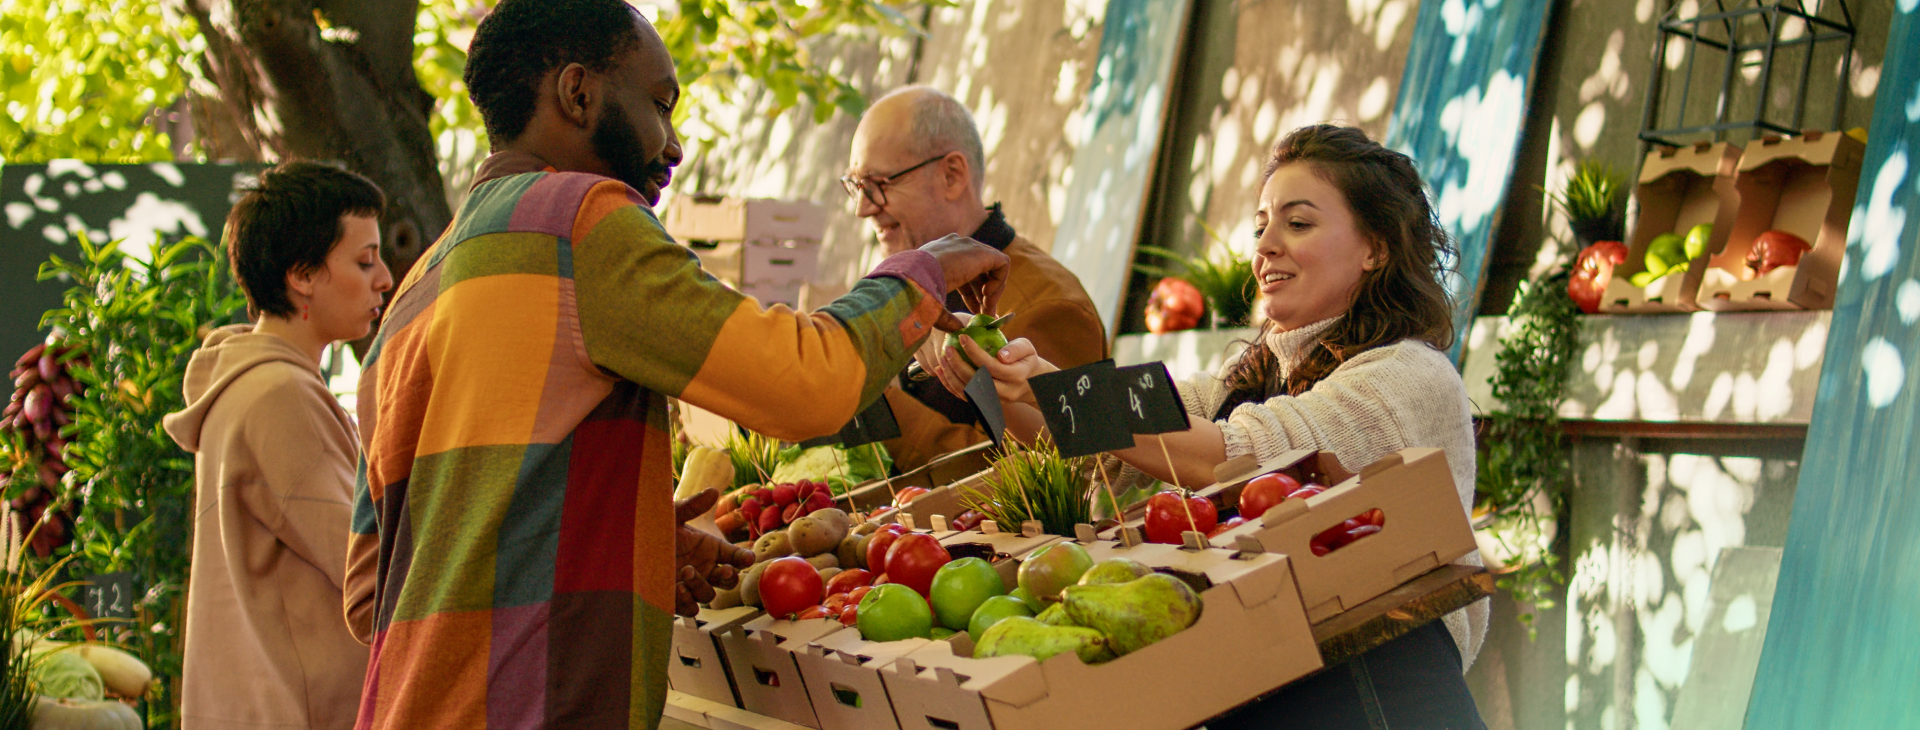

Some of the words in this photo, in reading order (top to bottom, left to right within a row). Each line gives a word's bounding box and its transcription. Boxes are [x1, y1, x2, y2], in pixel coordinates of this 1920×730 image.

[1059, 394, 1075, 434] 3
[1076, 374, 1091, 396] 50
[1128, 387, 1144, 419] 4
